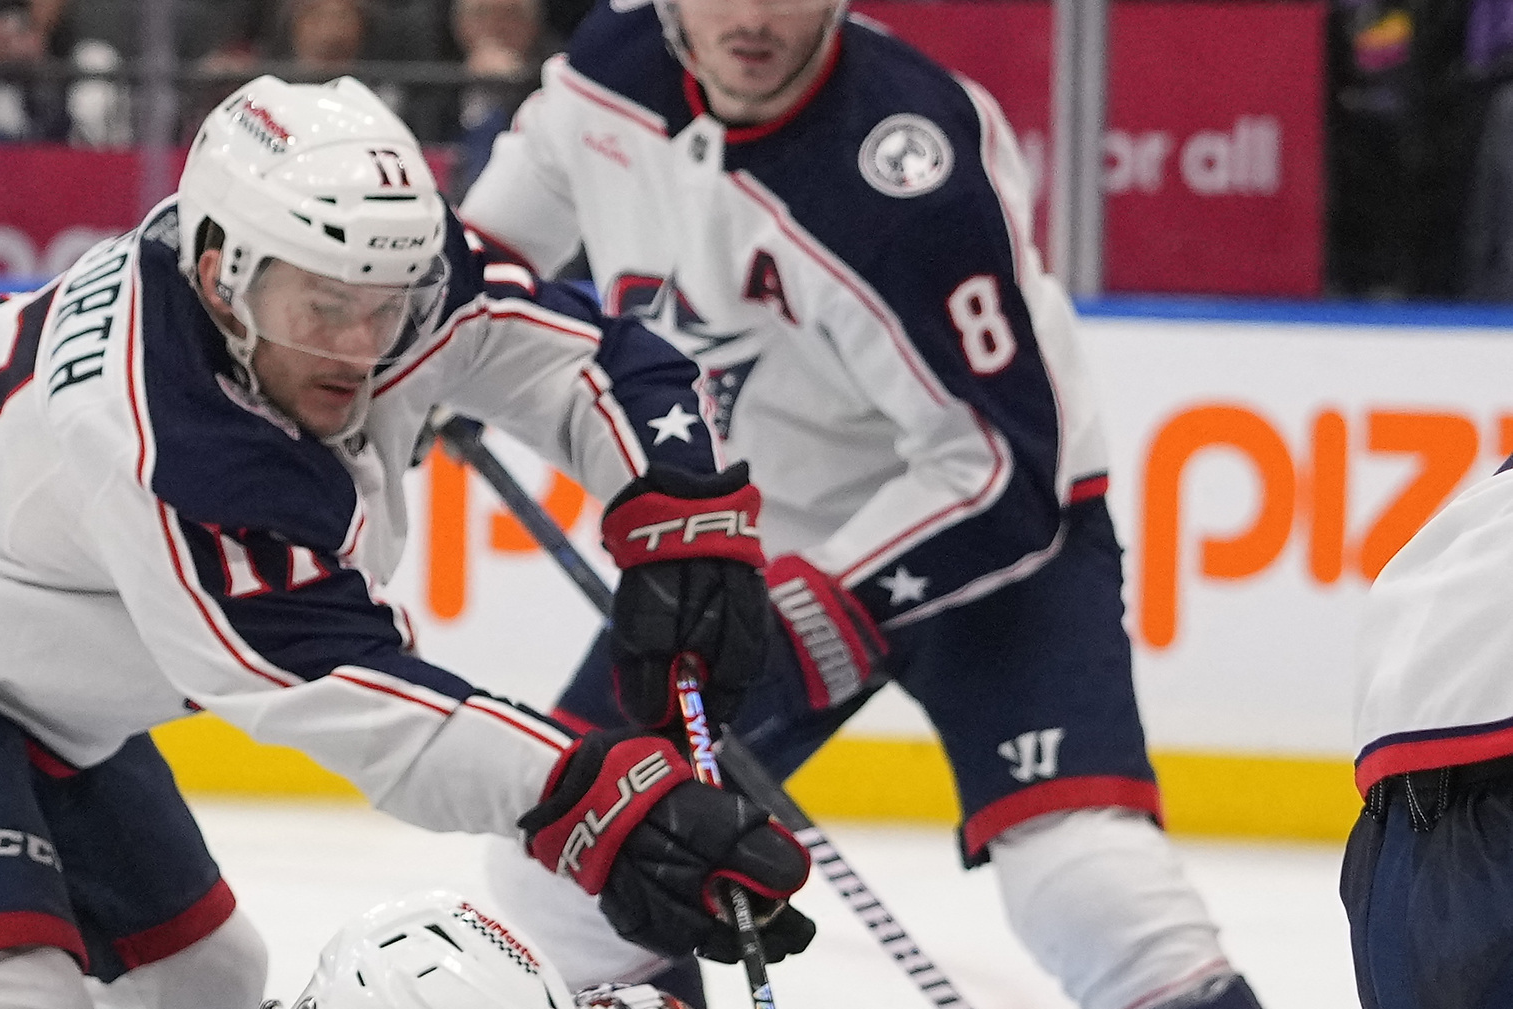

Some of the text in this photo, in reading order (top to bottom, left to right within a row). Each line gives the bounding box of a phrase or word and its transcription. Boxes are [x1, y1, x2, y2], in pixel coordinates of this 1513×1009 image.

[367, 148, 412, 188] 17
[1099, 128, 1171, 196] or
[1181, 114, 1283, 198] all
[743, 247, 800, 328] A
[945, 272, 1019, 377] 8
